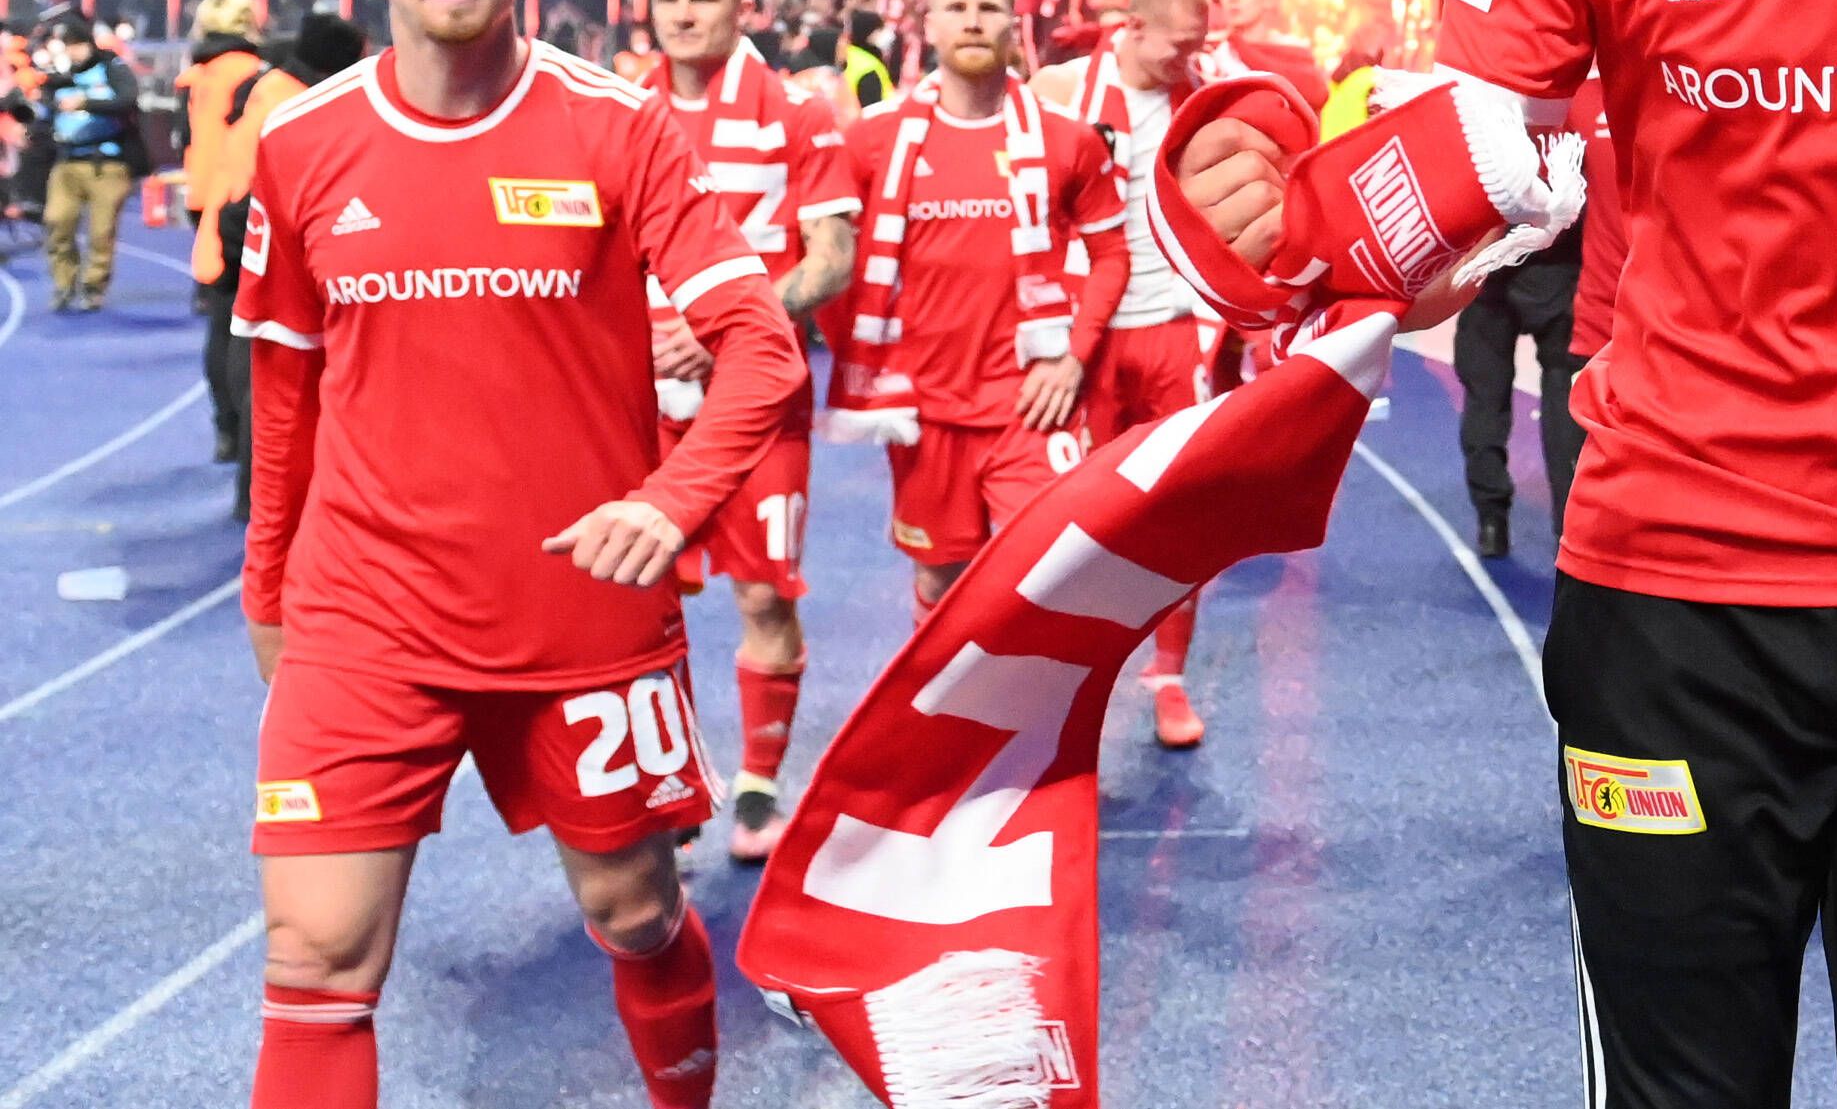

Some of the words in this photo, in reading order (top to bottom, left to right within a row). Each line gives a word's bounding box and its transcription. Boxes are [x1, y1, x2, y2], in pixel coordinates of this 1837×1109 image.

[1355, 147, 1437, 274] UNION
[325, 267, 582, 305] AROUNDTOWN
[562, 675, 689, 798] 20
[1625, 788, 1688, 818] UNION
